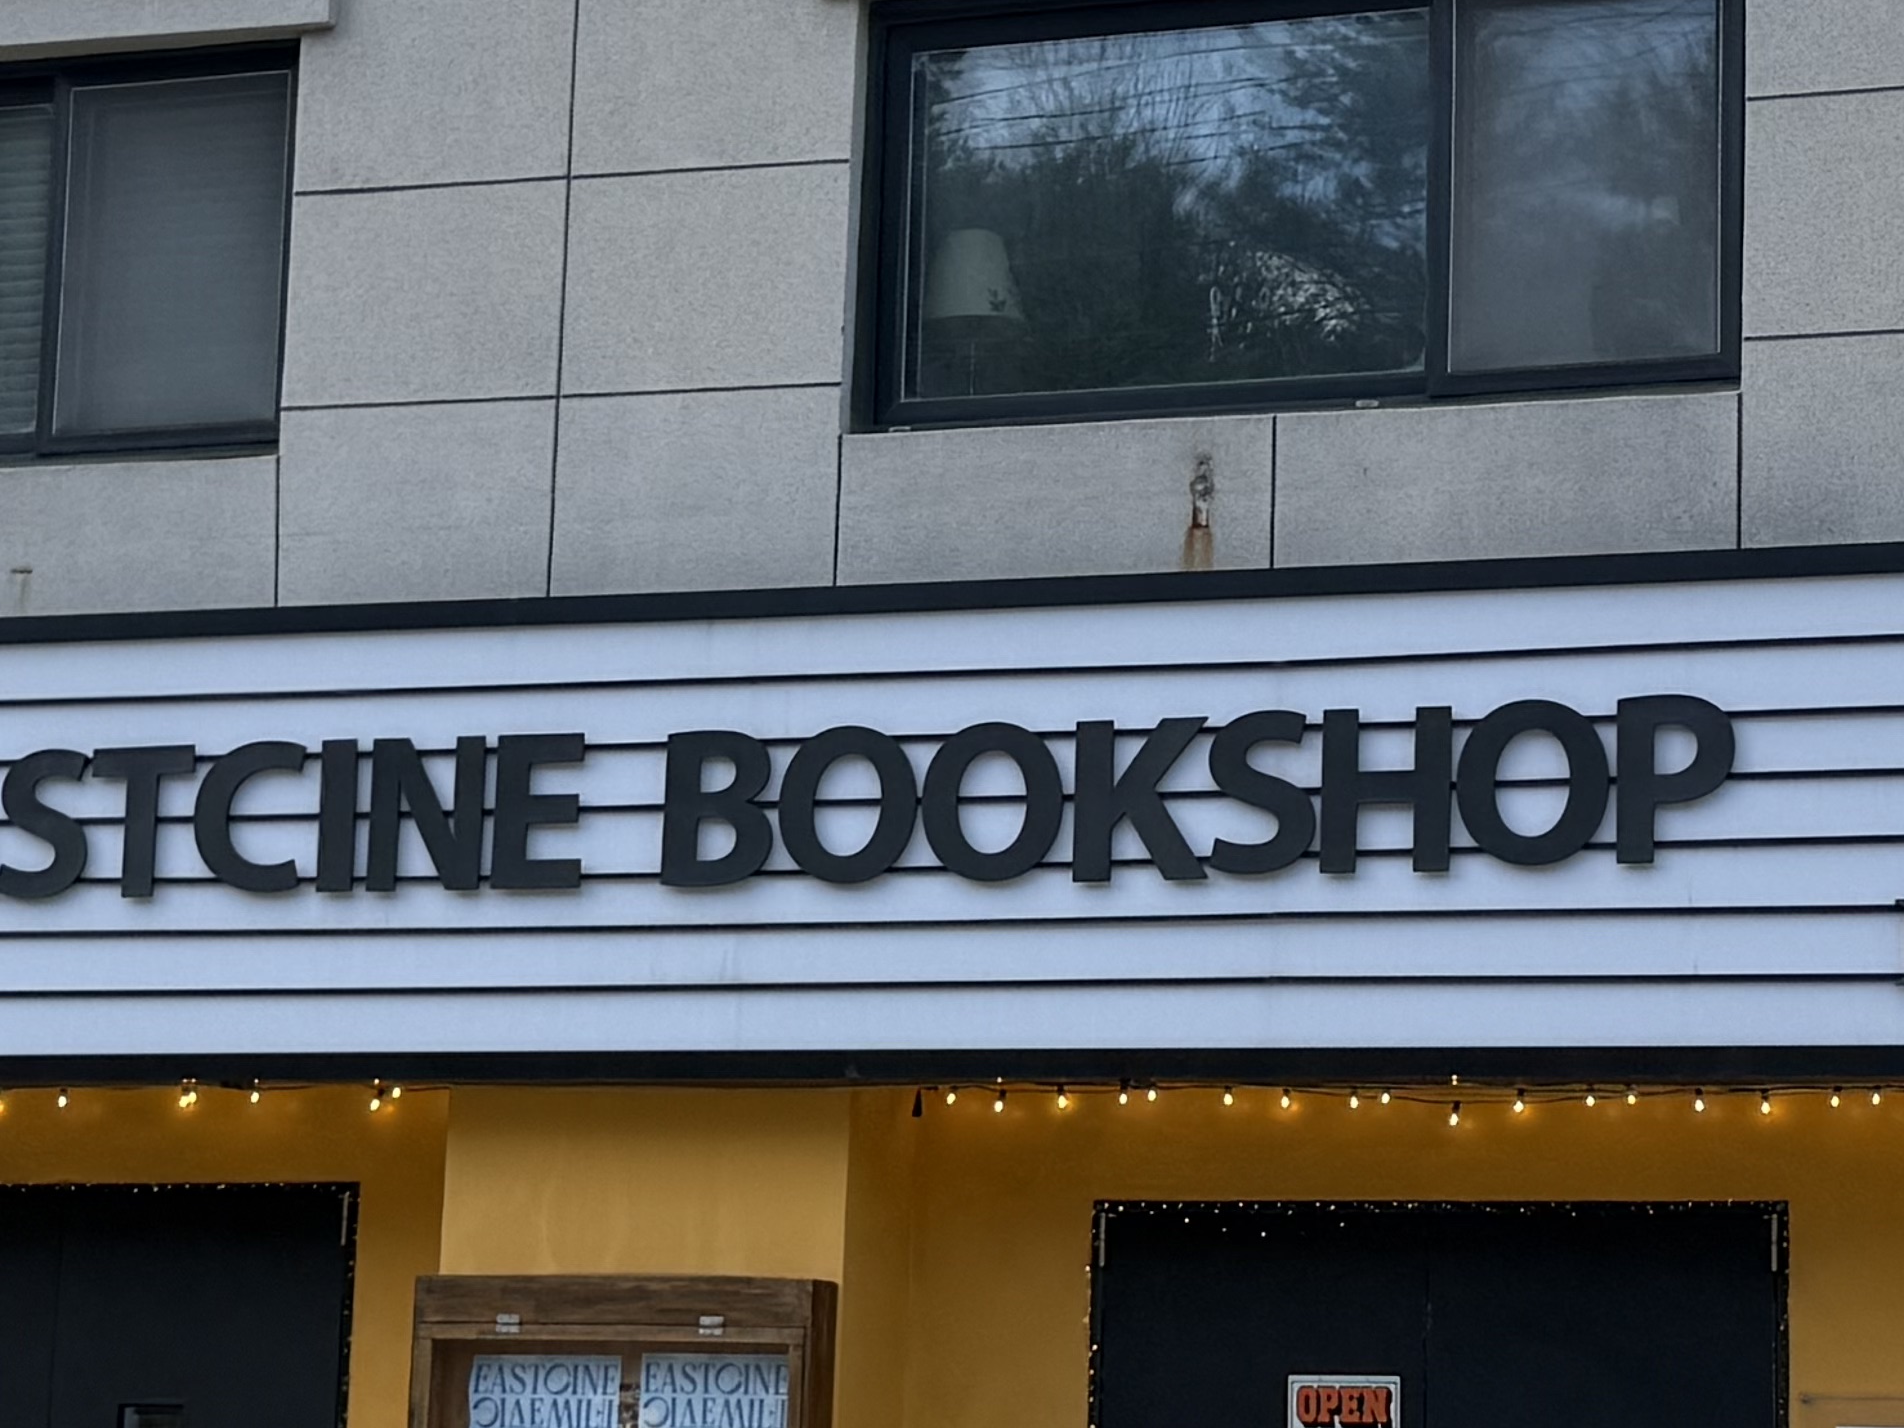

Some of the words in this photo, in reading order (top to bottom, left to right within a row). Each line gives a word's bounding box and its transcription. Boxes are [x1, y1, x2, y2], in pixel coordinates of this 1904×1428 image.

[659, 694, 1738, 887] BOOKSHOP
[473, 1362, 619, 1395] EASTCINE
[643, 1362, 789, 1395] EASTCINE
